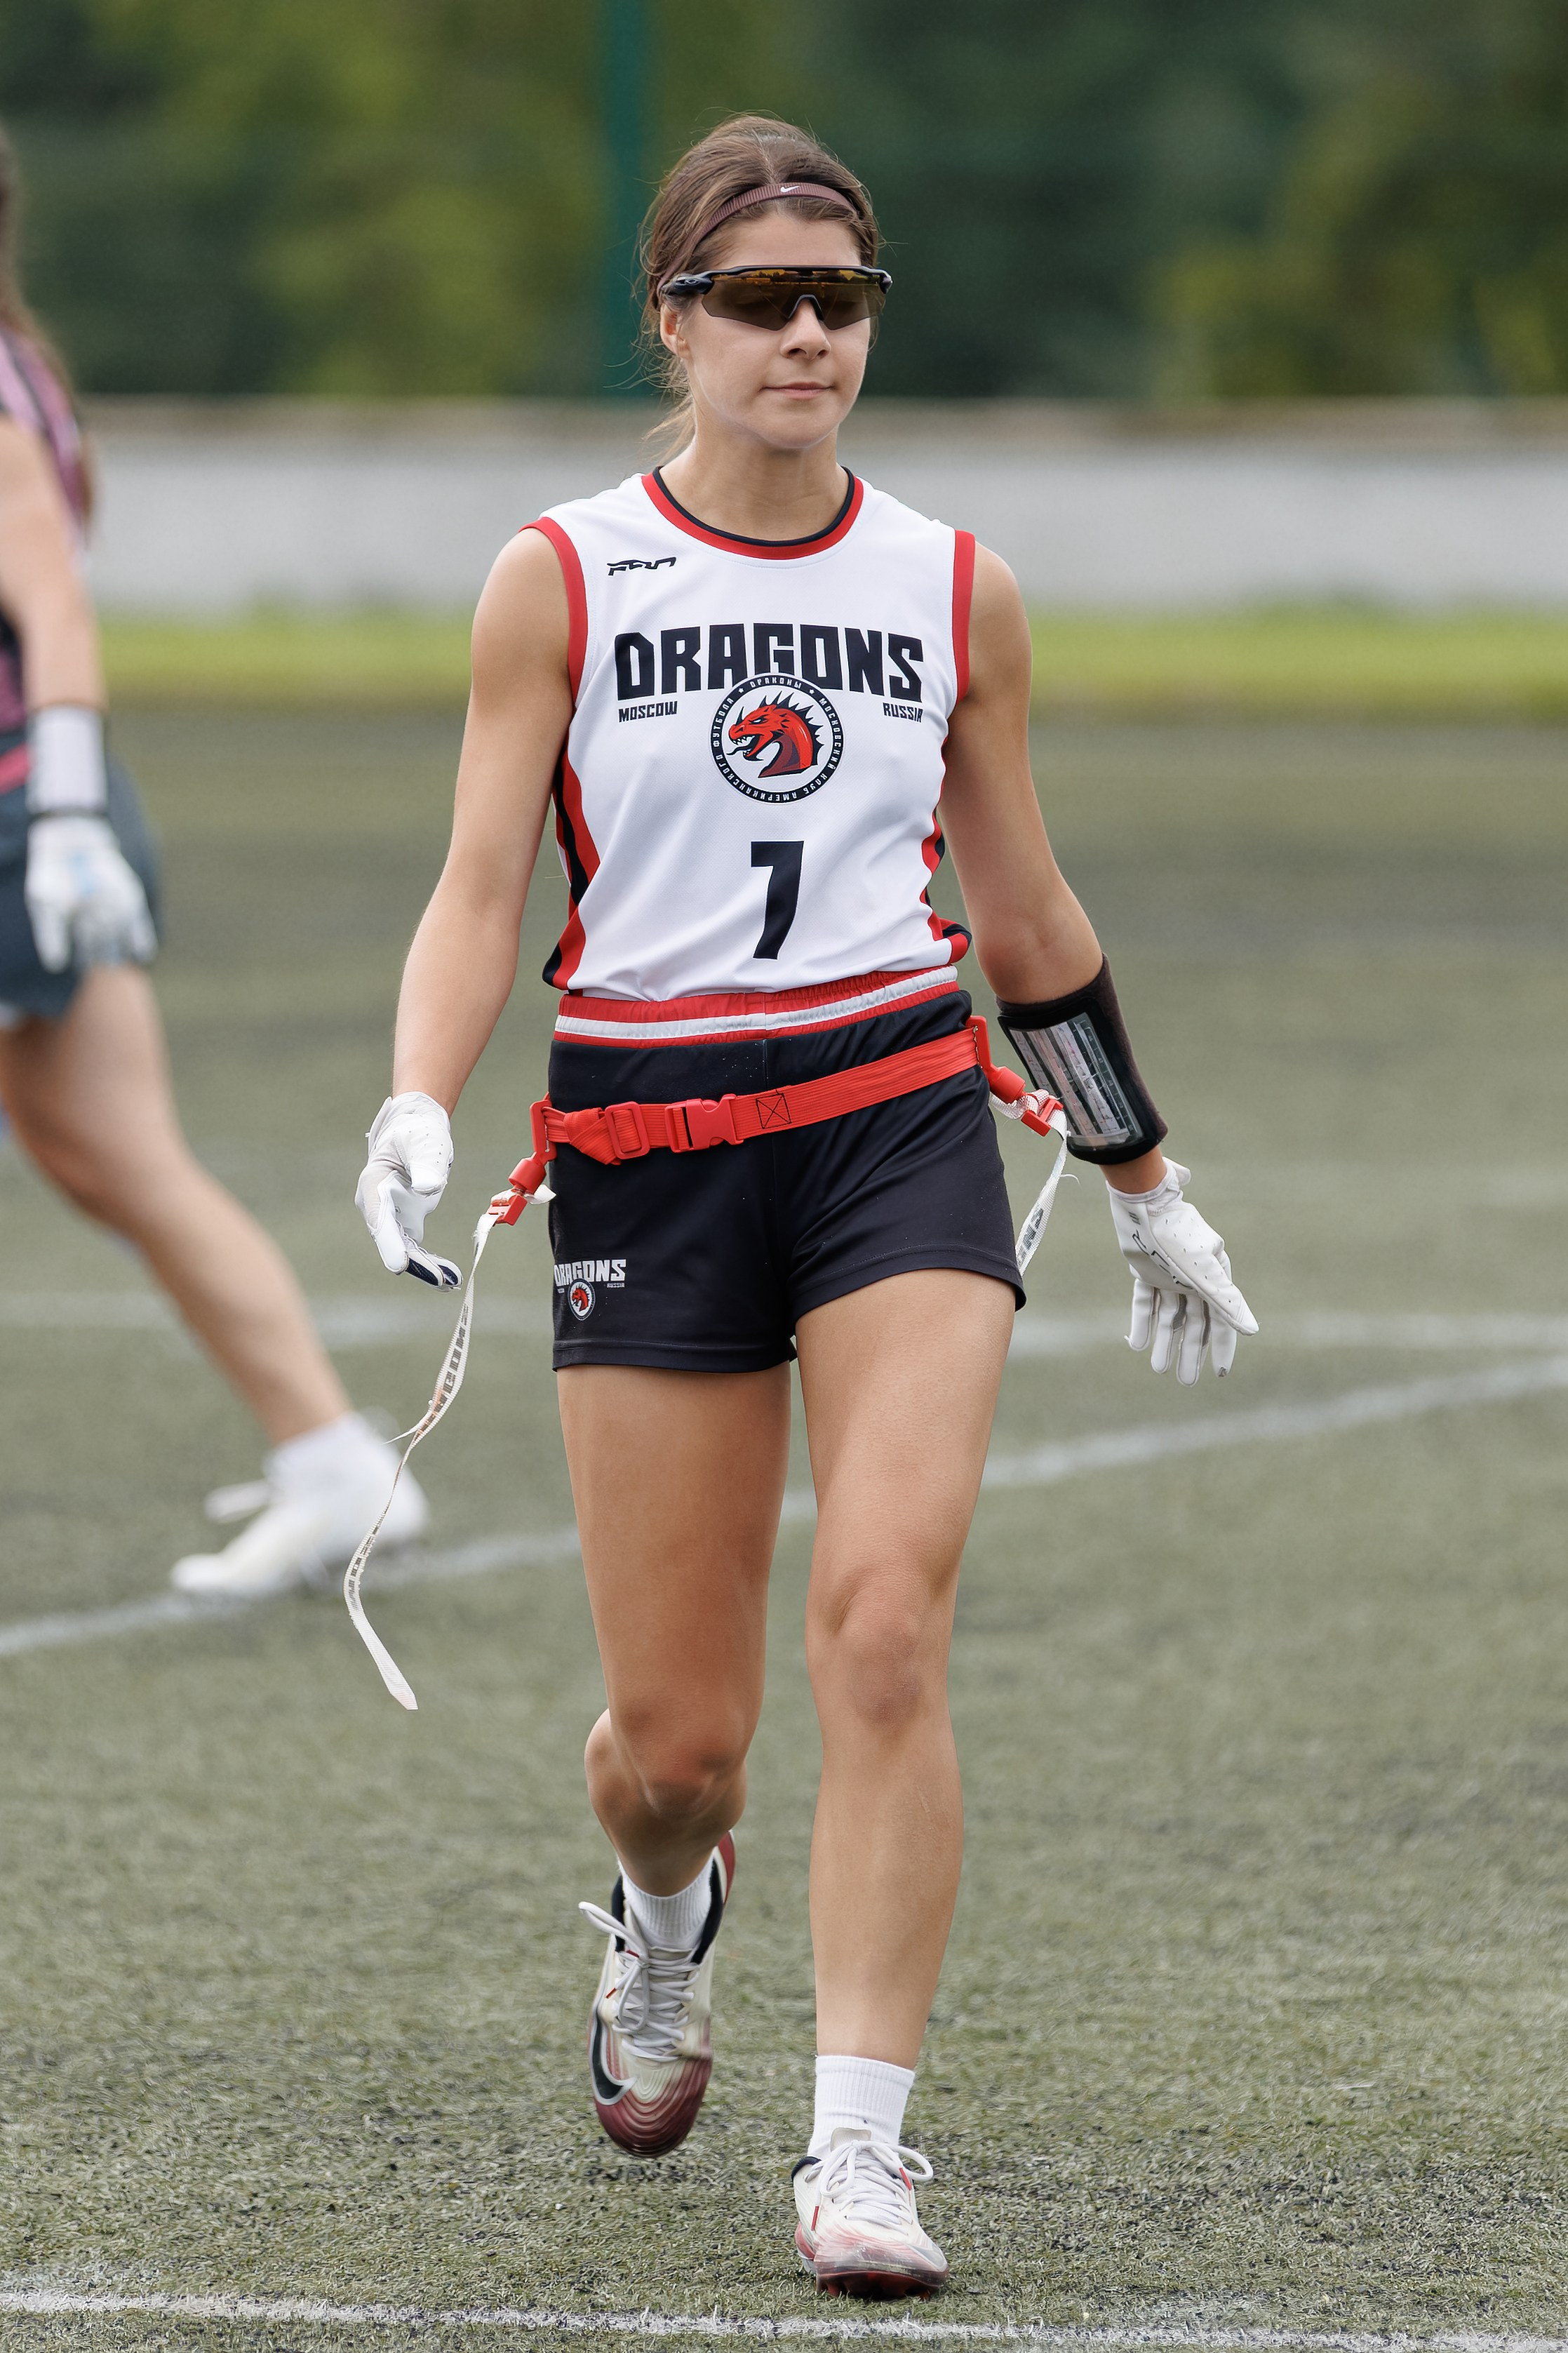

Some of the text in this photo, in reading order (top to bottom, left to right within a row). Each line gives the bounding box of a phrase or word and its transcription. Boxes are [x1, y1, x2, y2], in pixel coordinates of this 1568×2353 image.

[615, 622, 925, 703] DRAGONS
[618, 700, 678, 723] MOSCOW
[883, 702, 923, 723] RUSSIA
[751, 840, 805, 961] 7
[553, 1259, 627, 1287] DRAGONS
